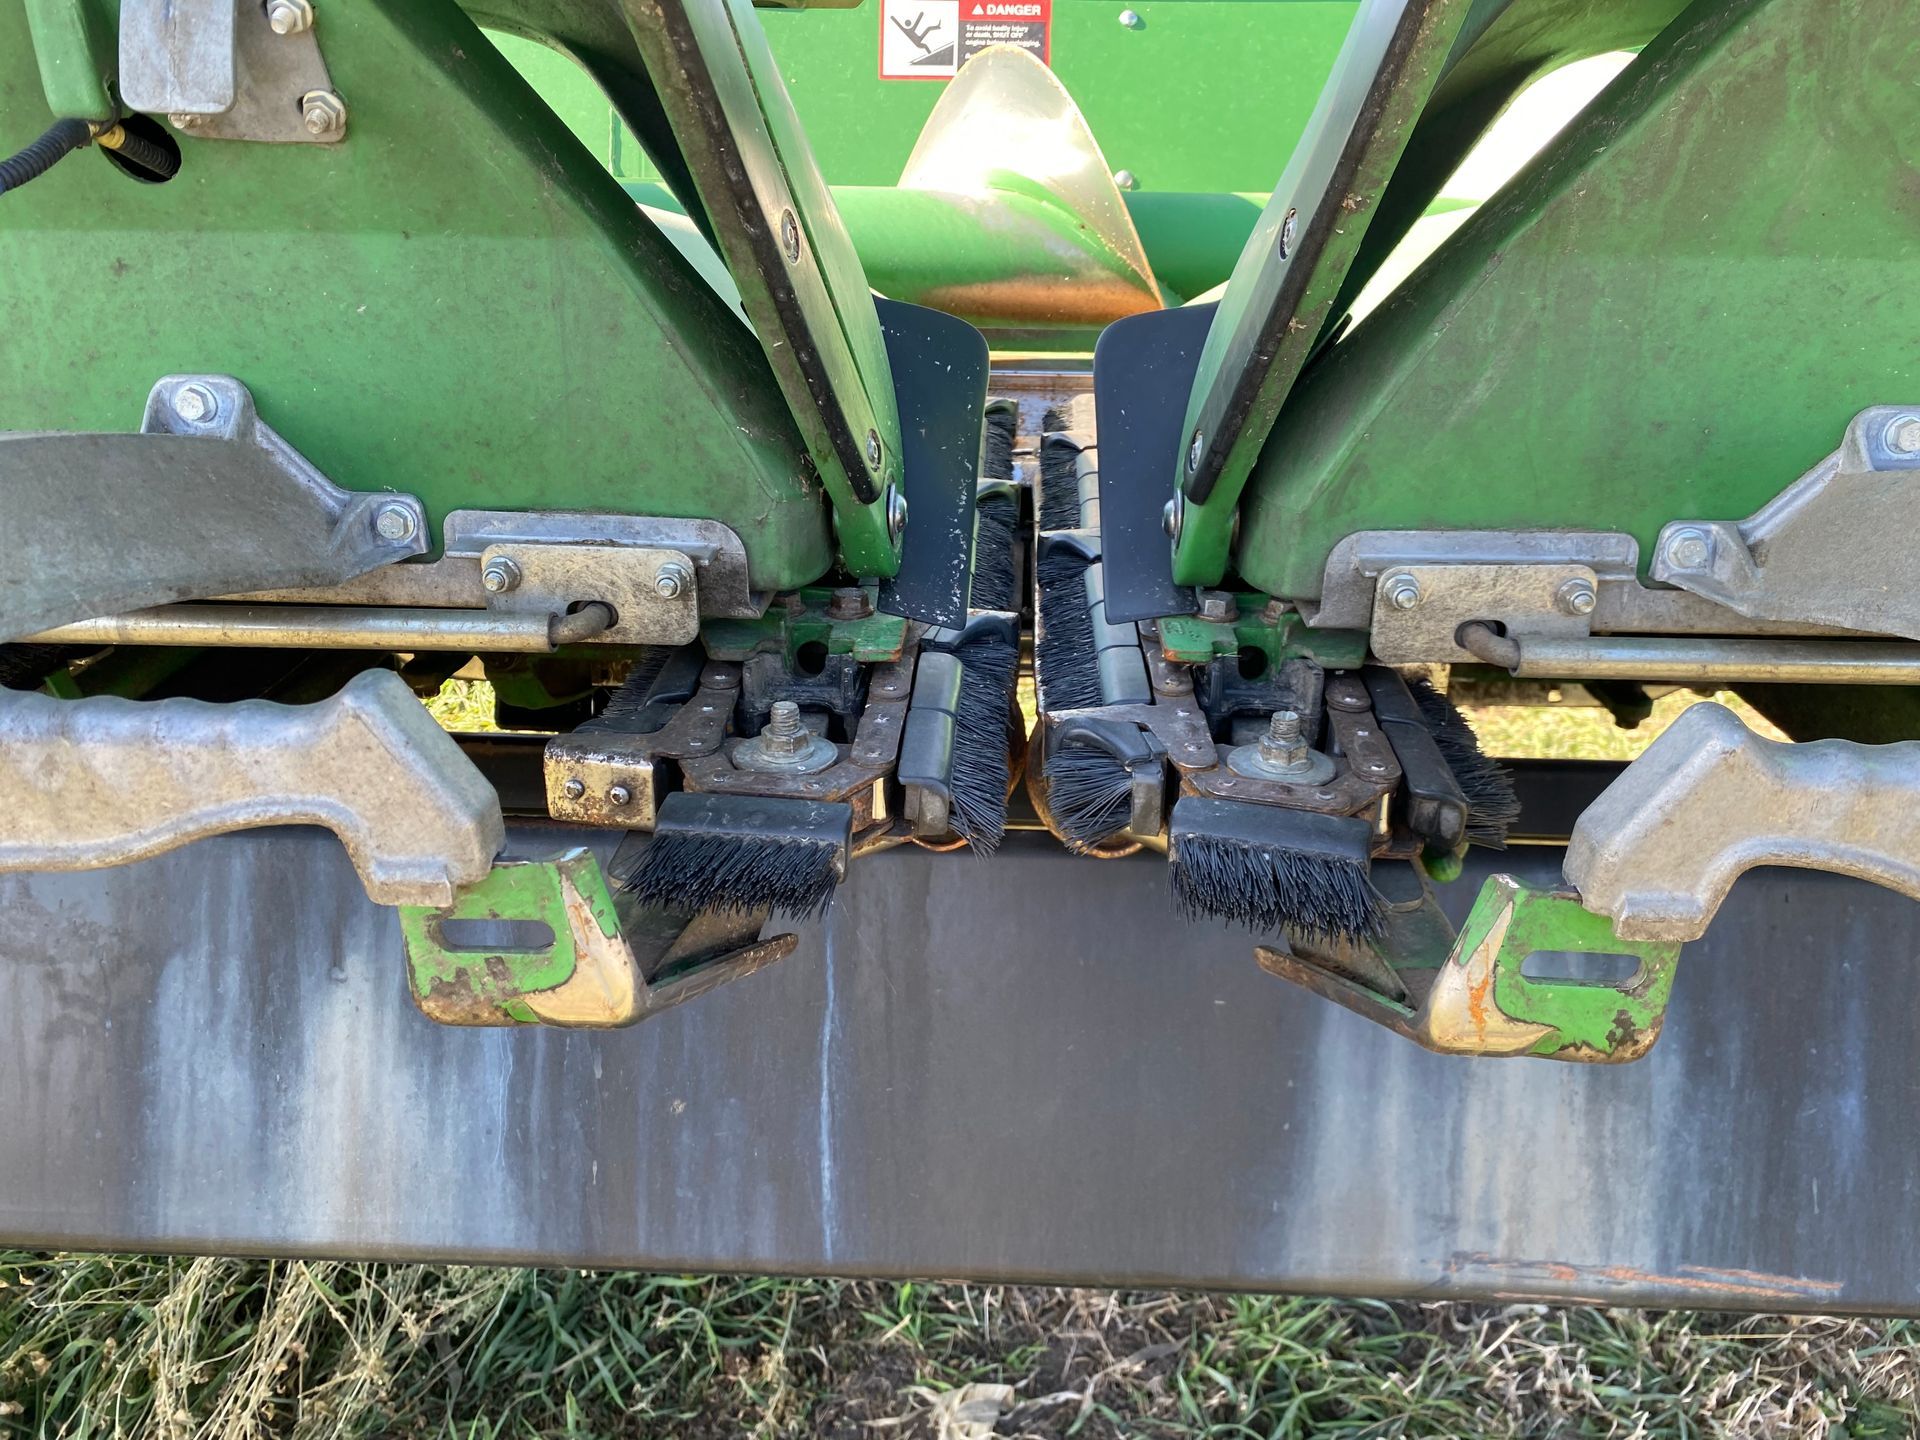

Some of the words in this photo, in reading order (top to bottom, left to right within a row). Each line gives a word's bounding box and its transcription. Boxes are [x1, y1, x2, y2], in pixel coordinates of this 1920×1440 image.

[986, 4, 1041, 16] DANGER
[992, 24, 1011, 33] bodily
[1012, 25, 1029, 33] injury
